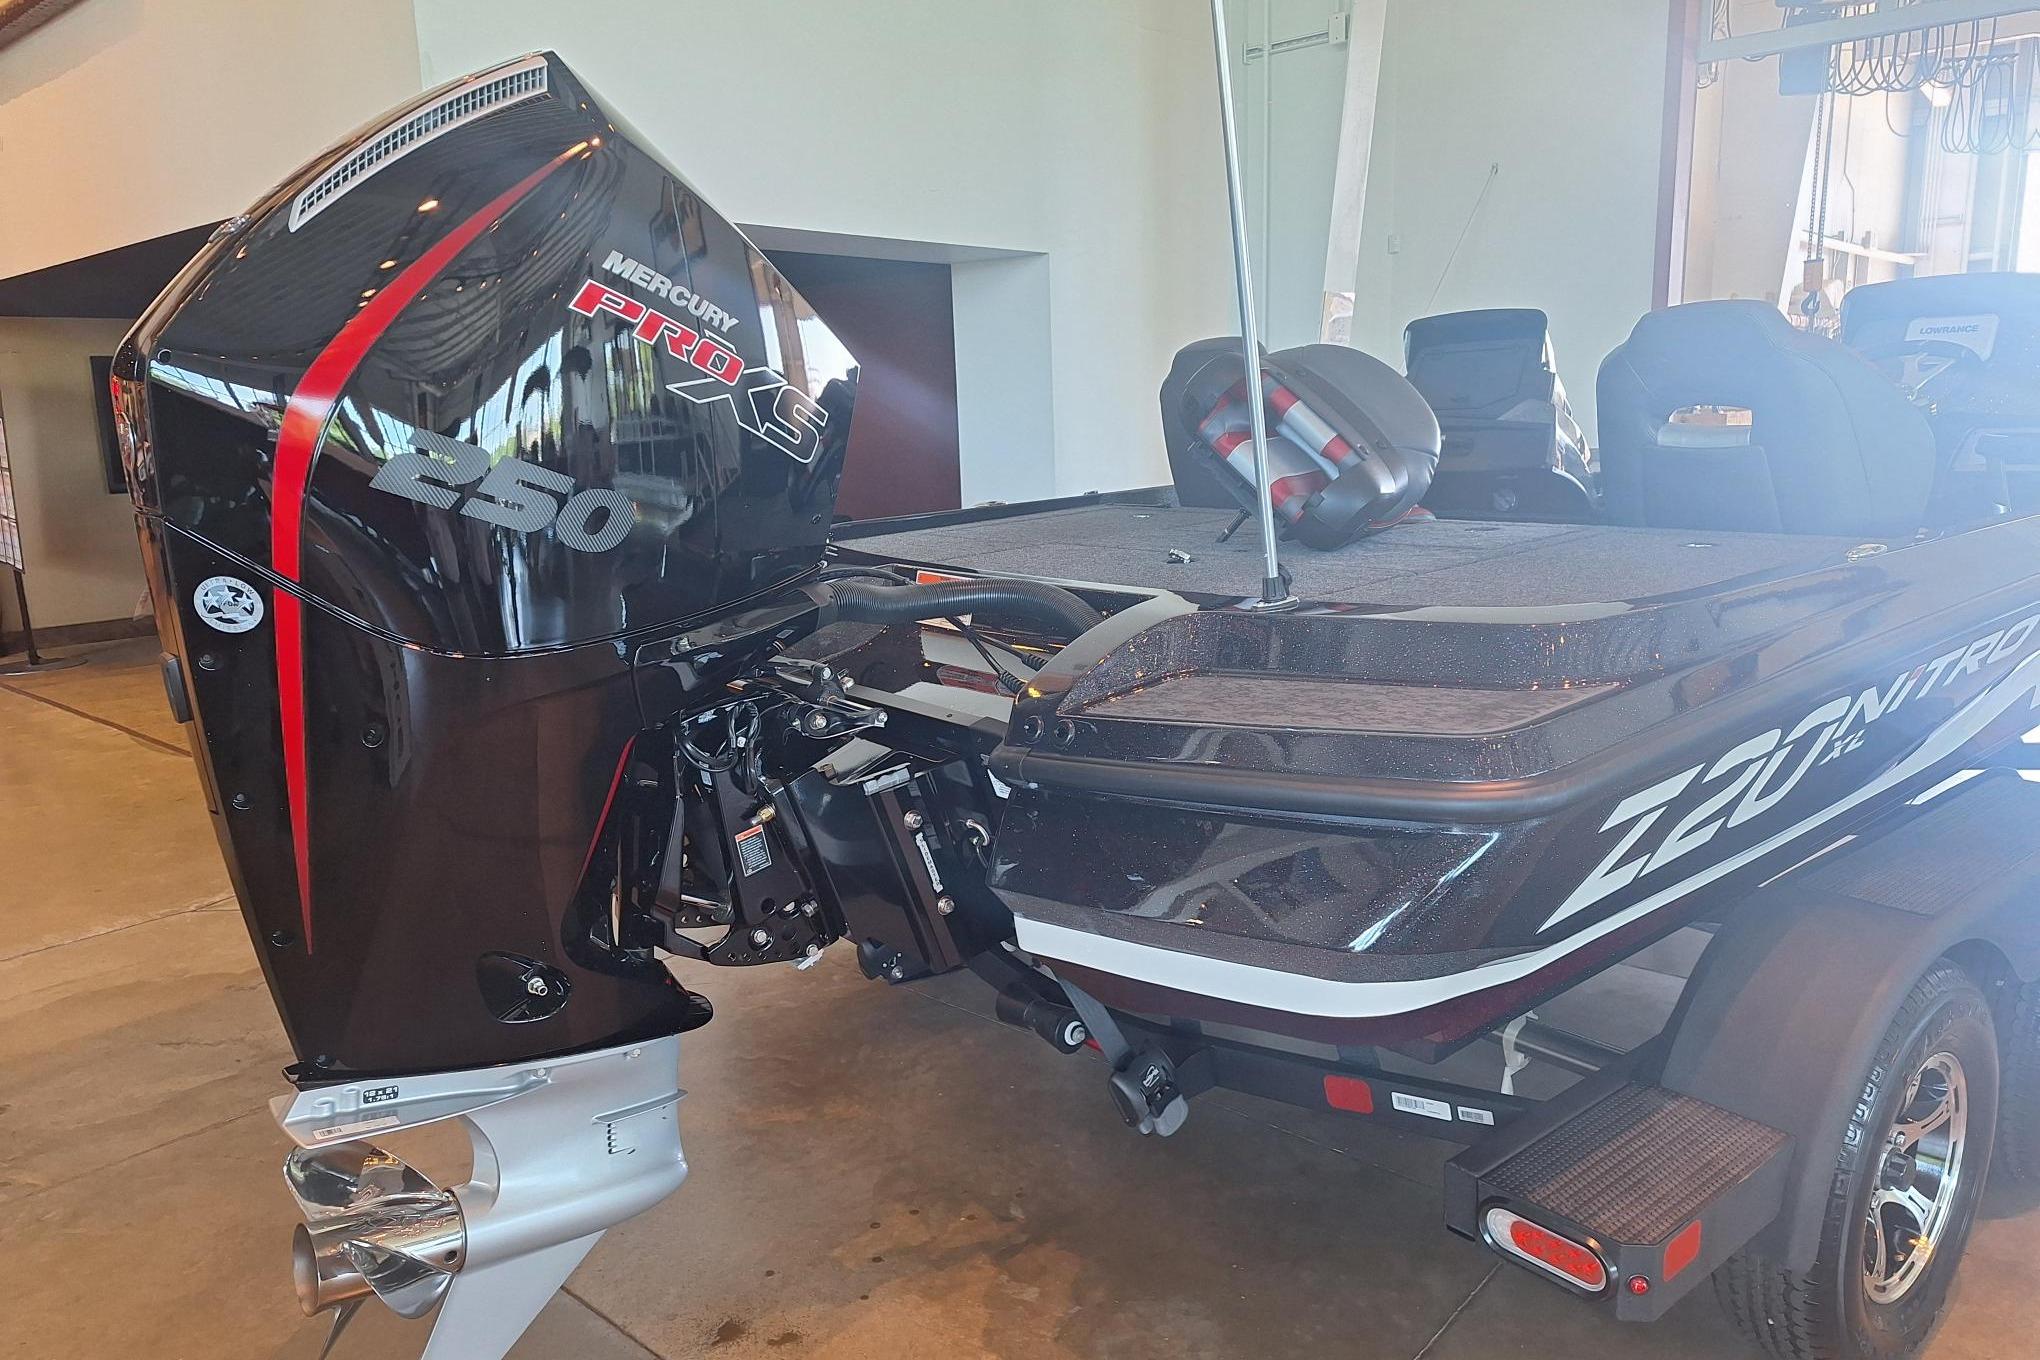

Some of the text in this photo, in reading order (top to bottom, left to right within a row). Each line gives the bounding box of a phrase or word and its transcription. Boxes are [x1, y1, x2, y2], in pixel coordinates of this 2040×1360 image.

[601, 250, 739, 334] MERCURY
[1920, 324, 1980, 335] LOWRANCE
[568, 279, 828, 463] PRO XS
[369, 428, 637, 553] 250
[1535, 614, 2040, 935] Z20 NITRO
